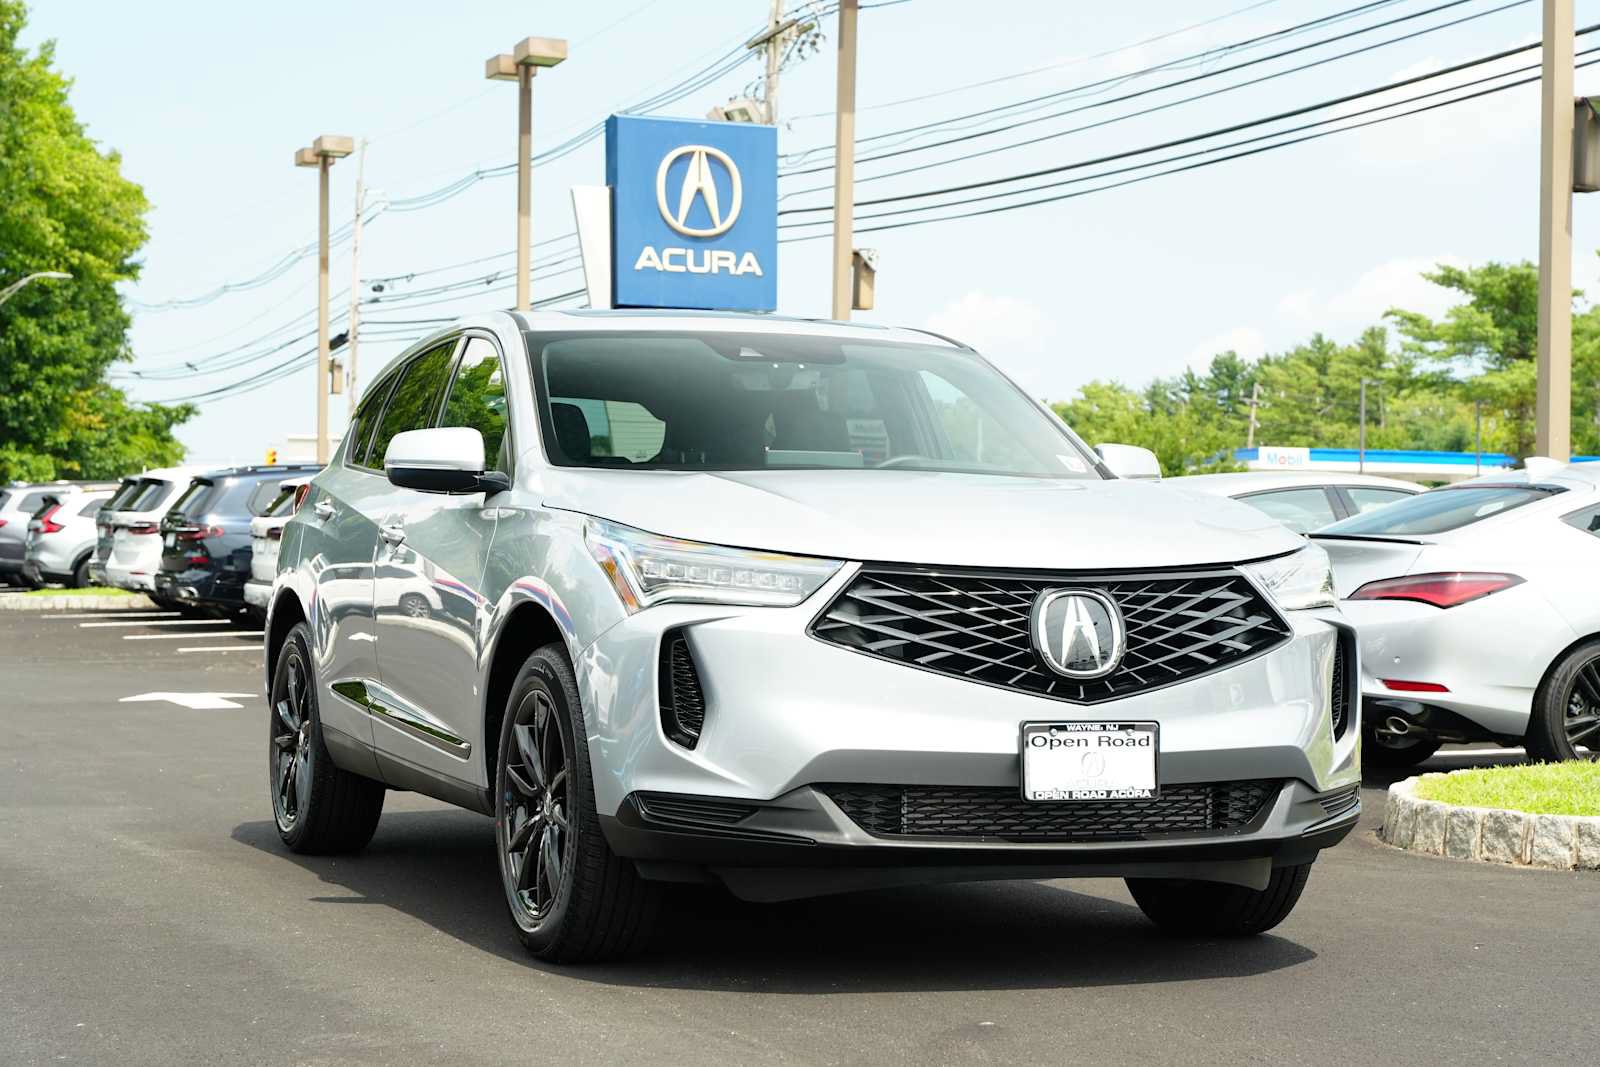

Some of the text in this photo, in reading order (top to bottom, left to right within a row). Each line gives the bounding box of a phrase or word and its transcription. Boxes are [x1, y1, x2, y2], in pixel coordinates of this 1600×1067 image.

[634, 245, 763, 276] ACURA
[1267, 453, 1303, 465] Mobil
[1106, 723, 1119, 731] NJ
[1031, 735, 1150, 750] Open Road
[1035, 788, 1152, 800] OPEN ROAD ACURA
